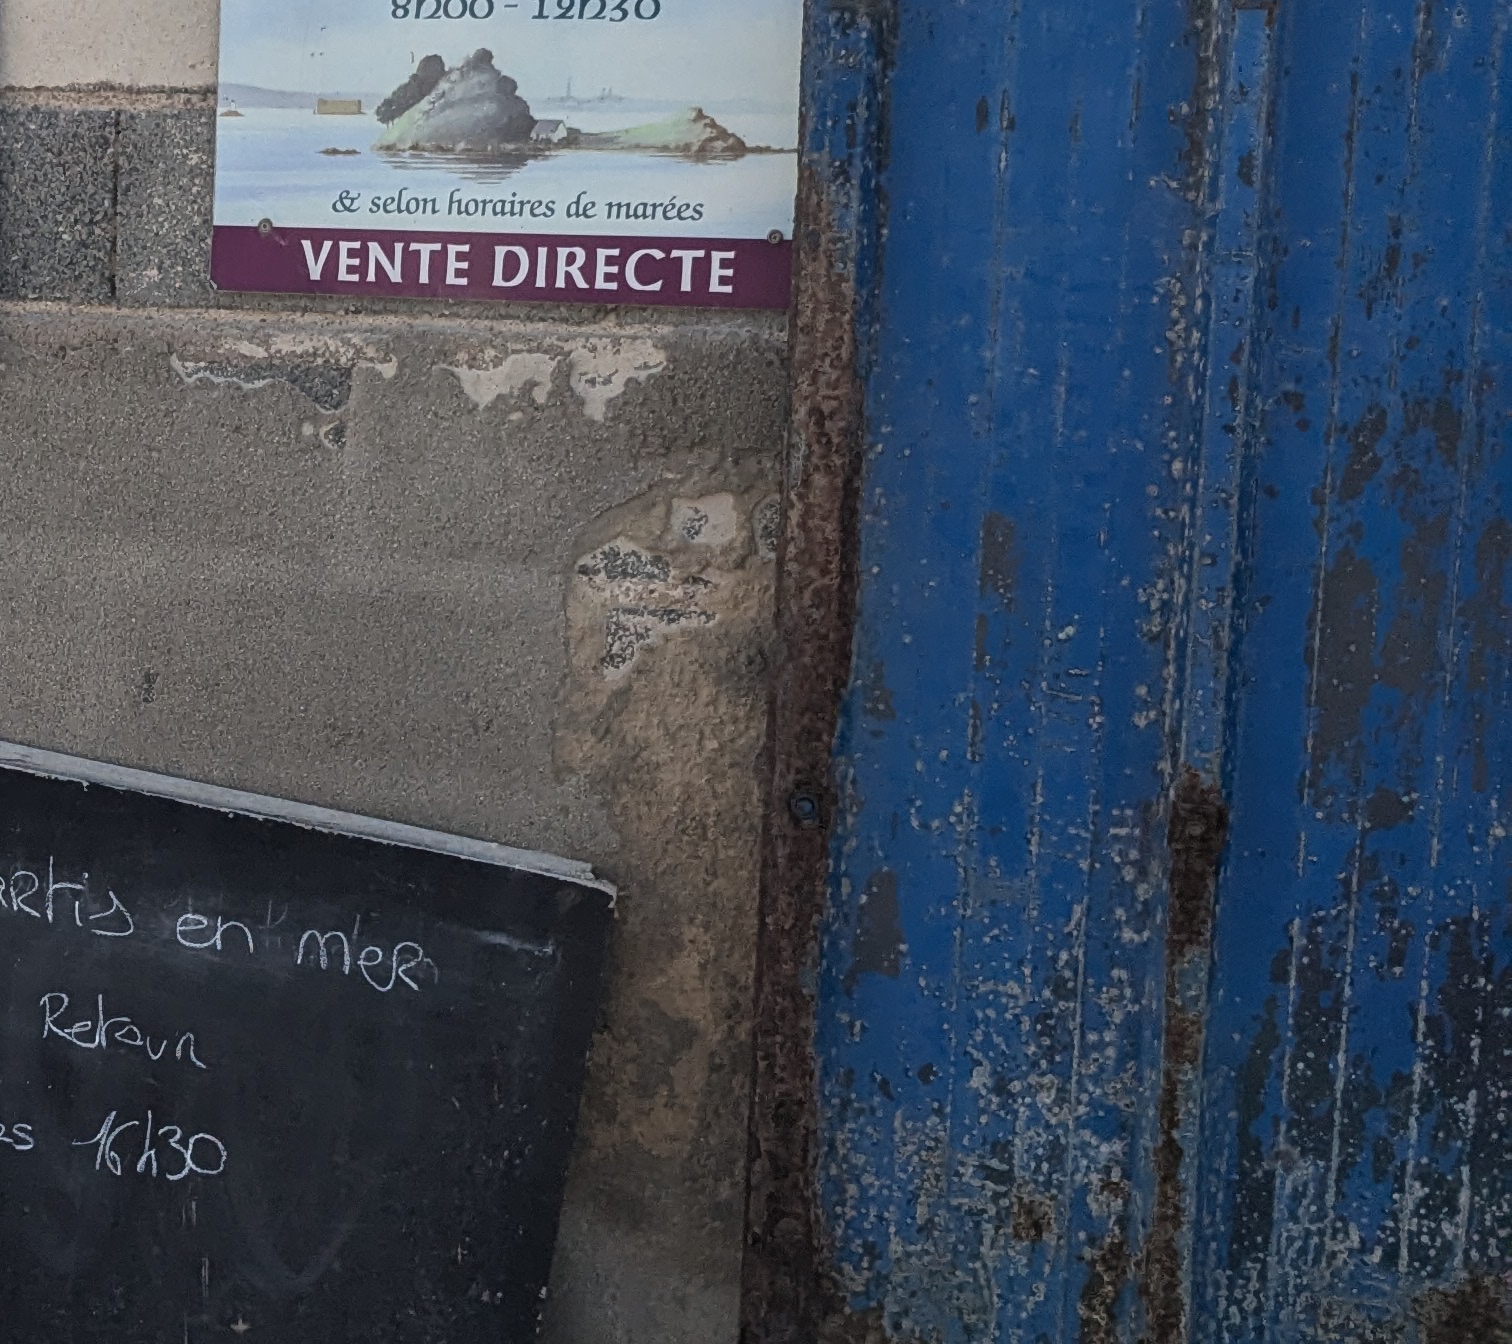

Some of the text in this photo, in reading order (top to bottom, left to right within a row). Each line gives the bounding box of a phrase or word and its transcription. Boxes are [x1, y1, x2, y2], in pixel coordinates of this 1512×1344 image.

[331, 189, 705, 223] & selon horaires de marées
[300, 238, 737, 294] VENTE DIRECTE
[175, 911, 255, 954] en
[71, 1109, 229, 1181] 16h30
